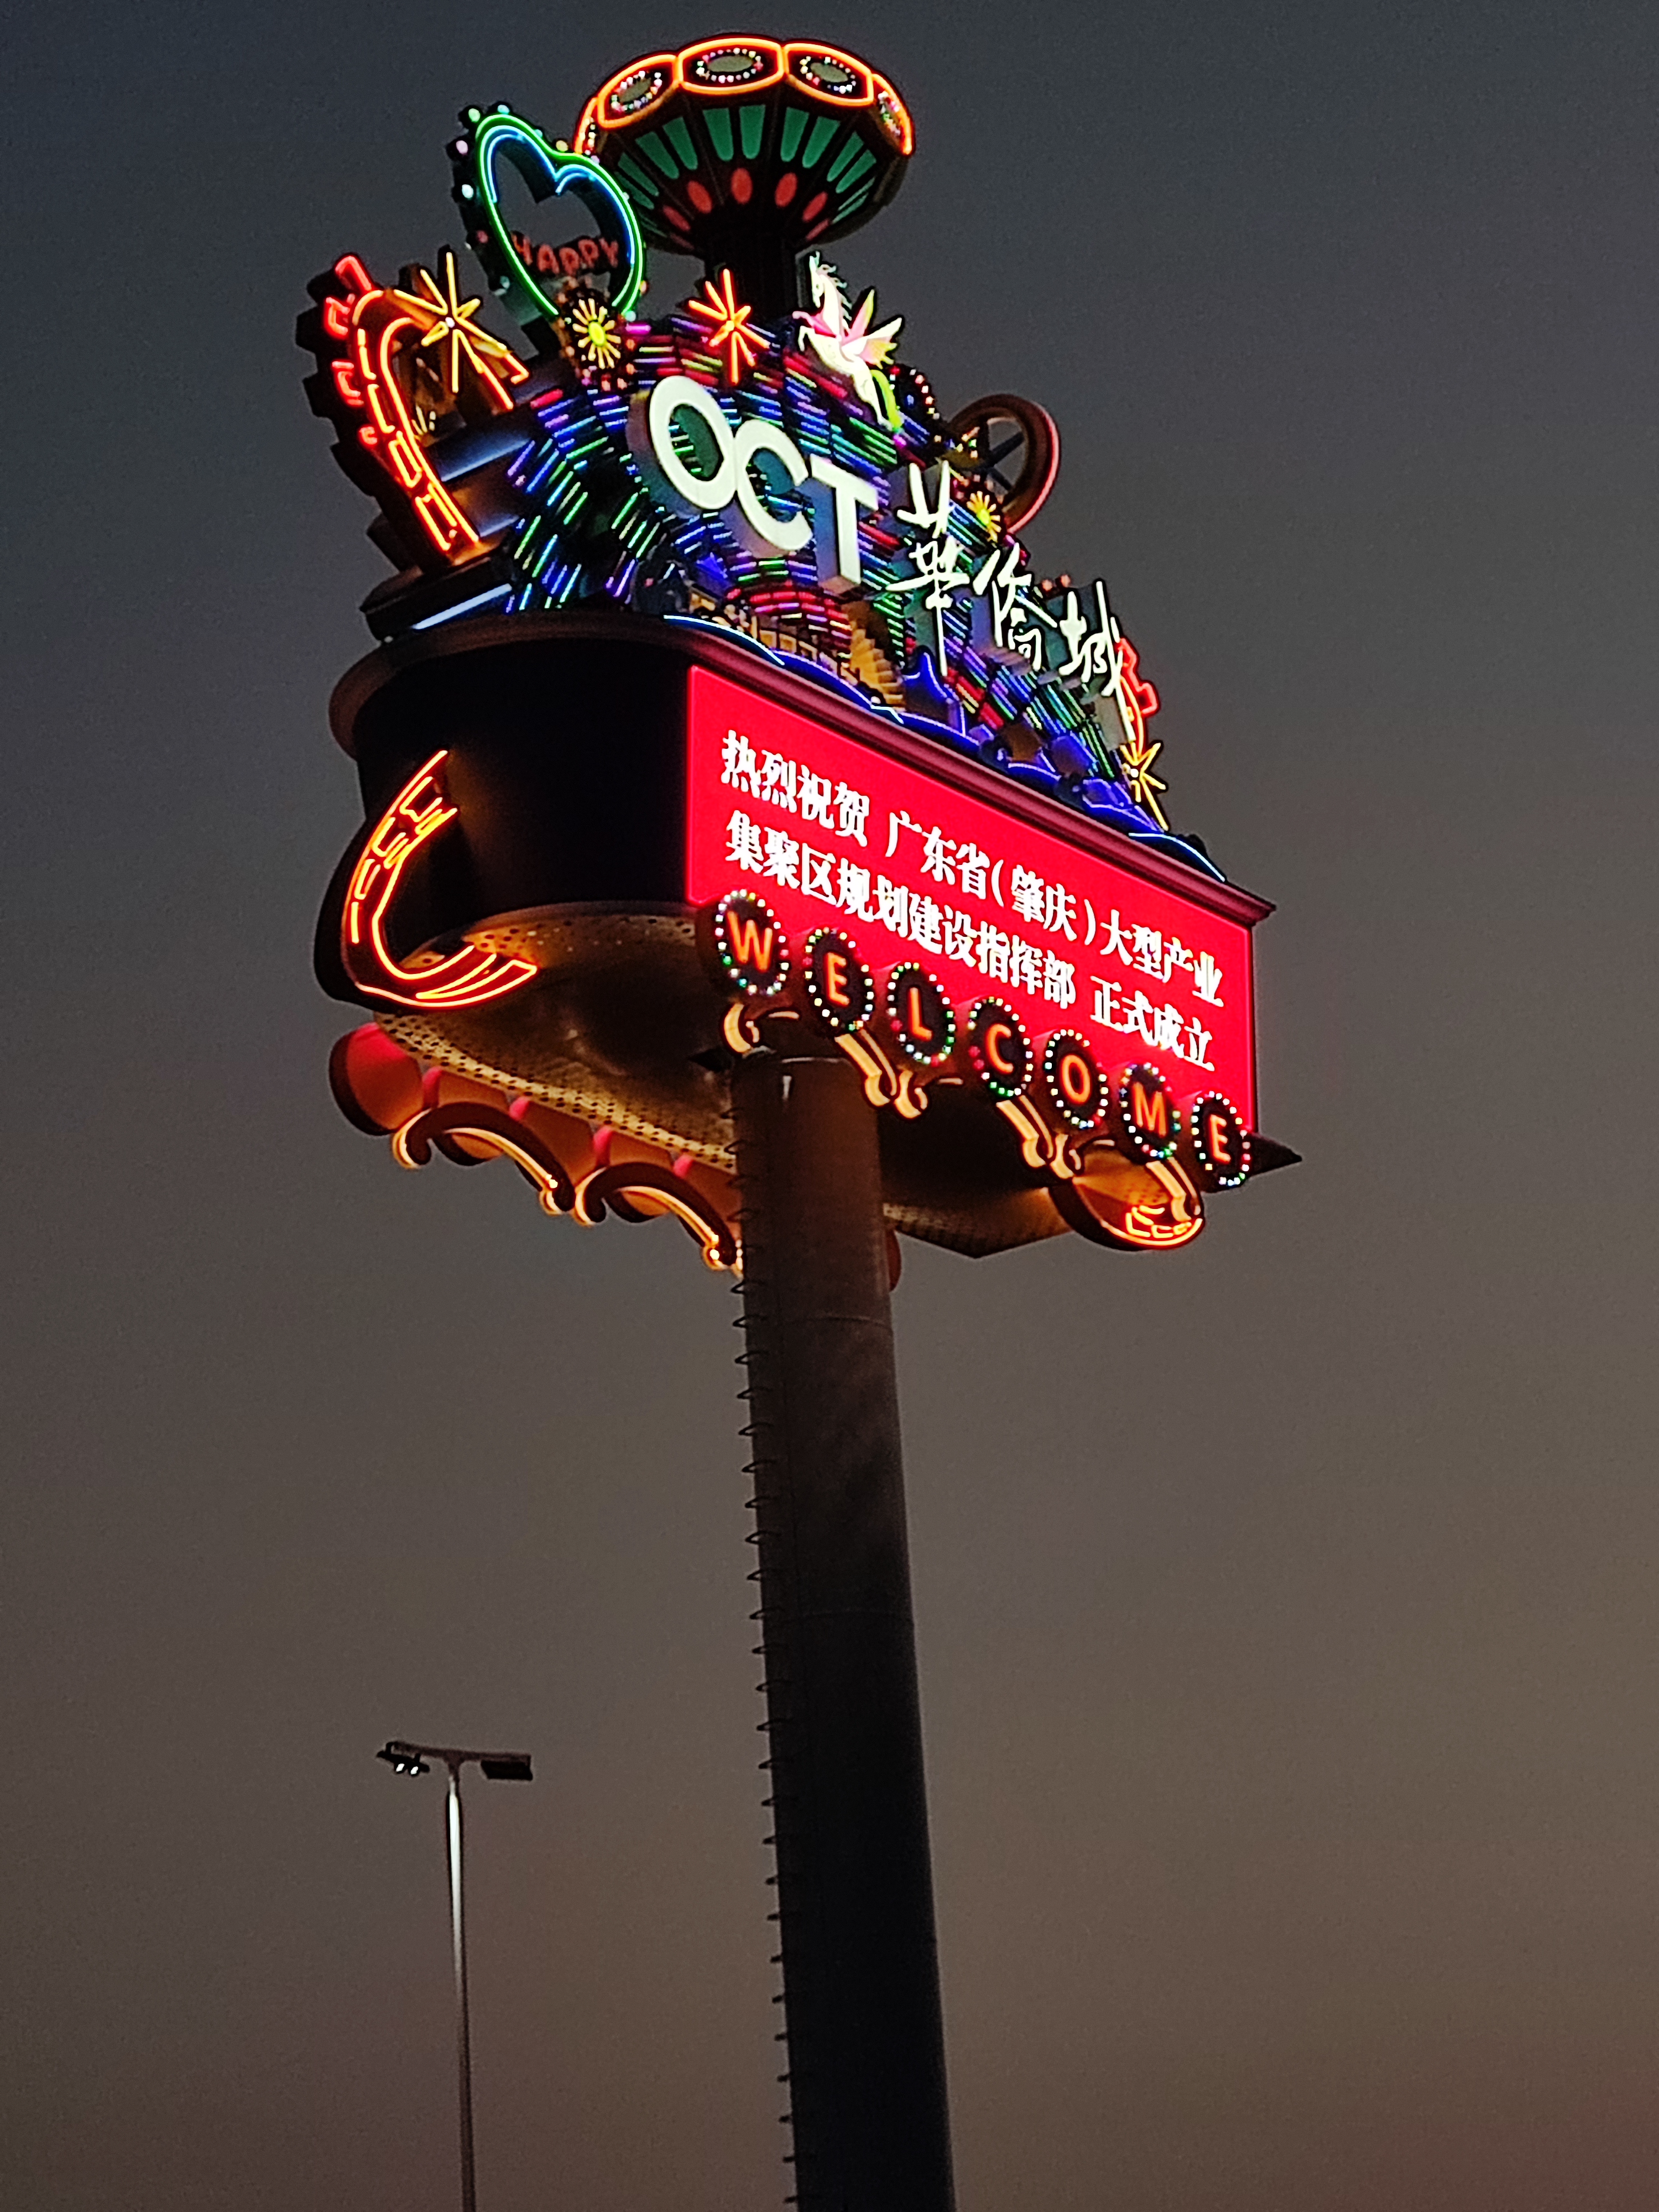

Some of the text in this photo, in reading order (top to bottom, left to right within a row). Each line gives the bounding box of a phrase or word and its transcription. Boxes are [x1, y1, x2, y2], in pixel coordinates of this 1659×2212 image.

[649, 375, 879, 585] OCT
[721, 729, 870, 847] 热烈祝贺
[725, 810, 1215, 1072] 集聚区规划建设指挥部 正式成立
[726, 911, 1232, 1164] WELCOME
